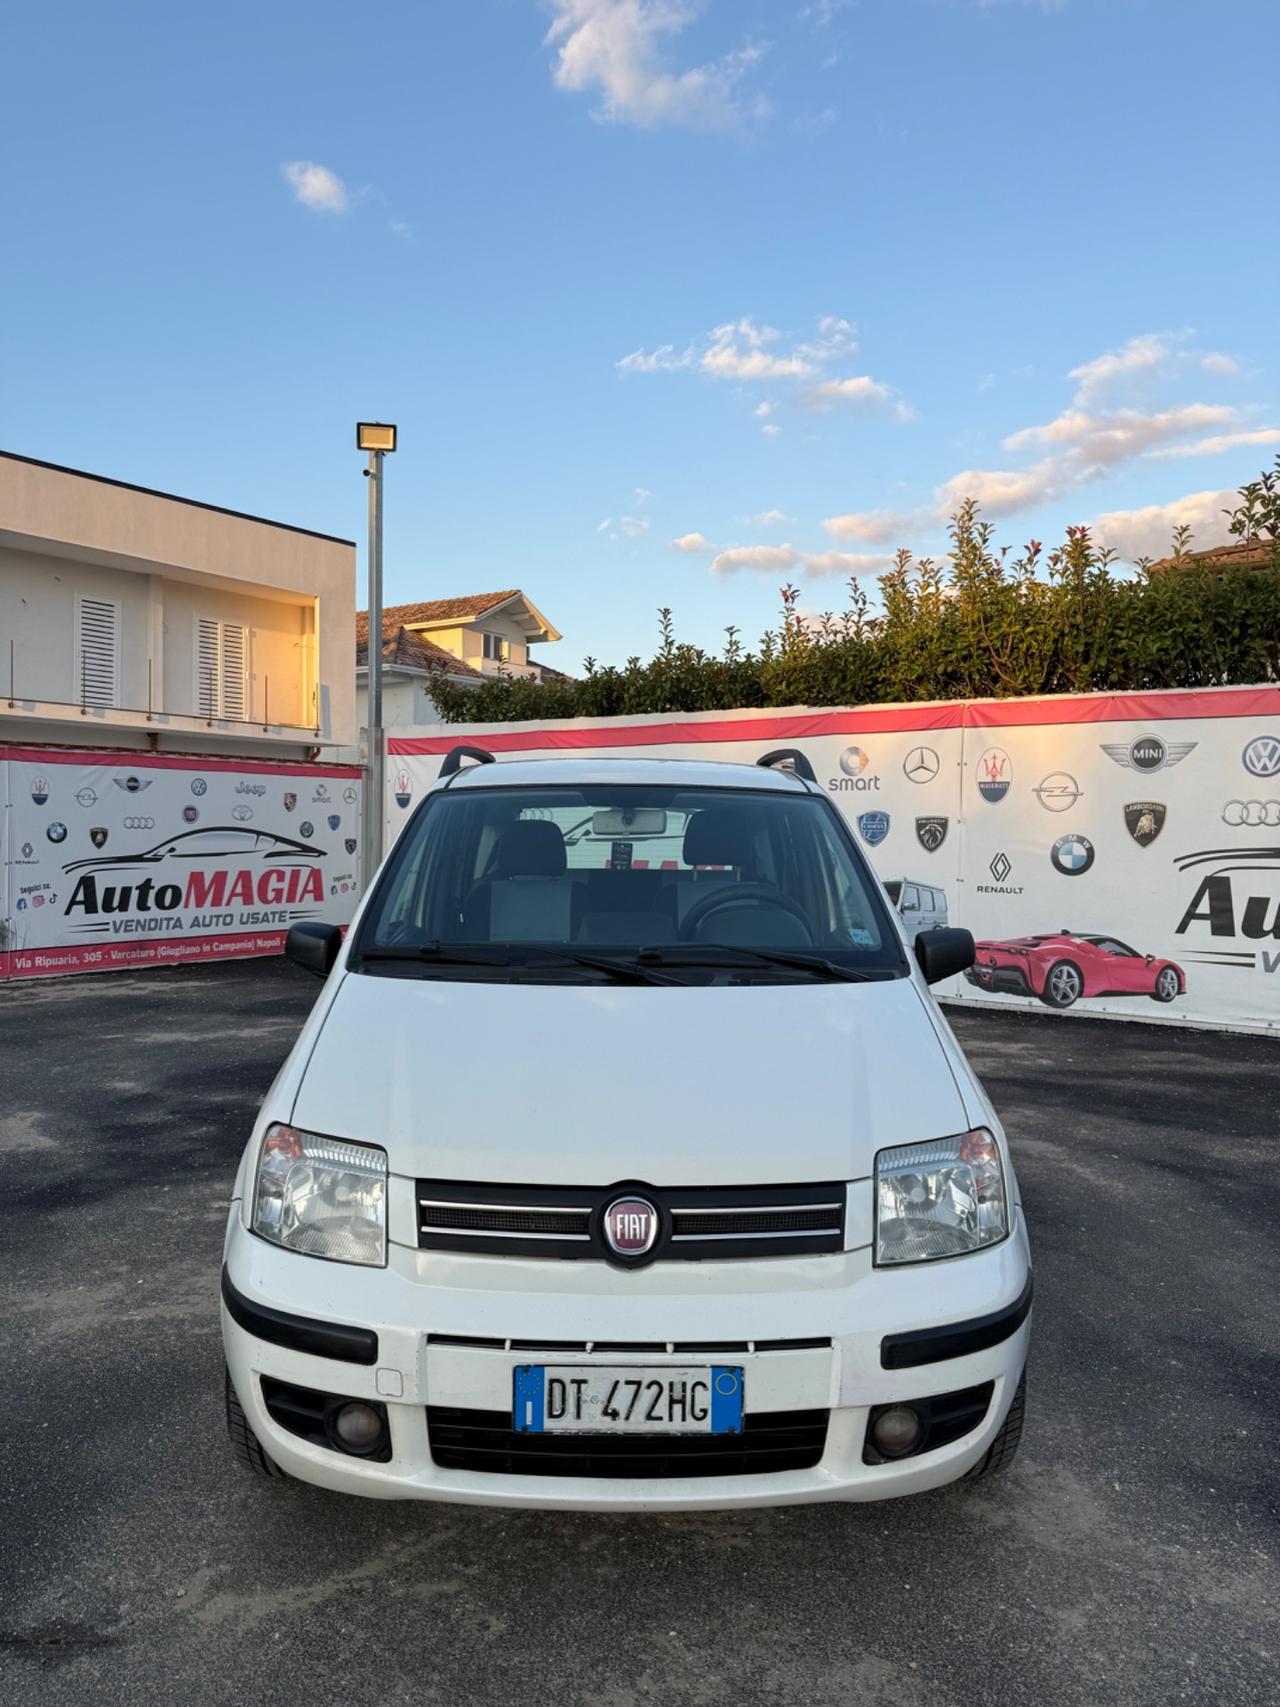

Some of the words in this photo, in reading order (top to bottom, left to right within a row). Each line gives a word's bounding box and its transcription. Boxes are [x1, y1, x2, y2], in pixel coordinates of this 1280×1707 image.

[1133, 748, 1163, 760] MINI
[235, 781, 266, 797] Jeep
[828, 775, 881, 792] smart
[977, 885, 1024, 895] RENAULT
[112, 917, 183, 934] VENDITA
[189, 913, 234, 929] AUTO
[239, 910, 288, 926] USATE
[15, 958, 32, 969] Via
[35, 953, 80, 968] Ripuaria,
[83, 951, 102, 962] 305
[111, 948, 155, 960] Varcaturo
[157, 945, 200, 958] (Giugliano
[202, 943, 211, 952] in
[213, 940, 255, 952] Campania)
[257, 937, 280, 949] Napoli
[616, 1213, 648, 1240] FIAT
[547, 1378, 588, 1420] DT
[602, 1379, 709, 1422] 472HG
